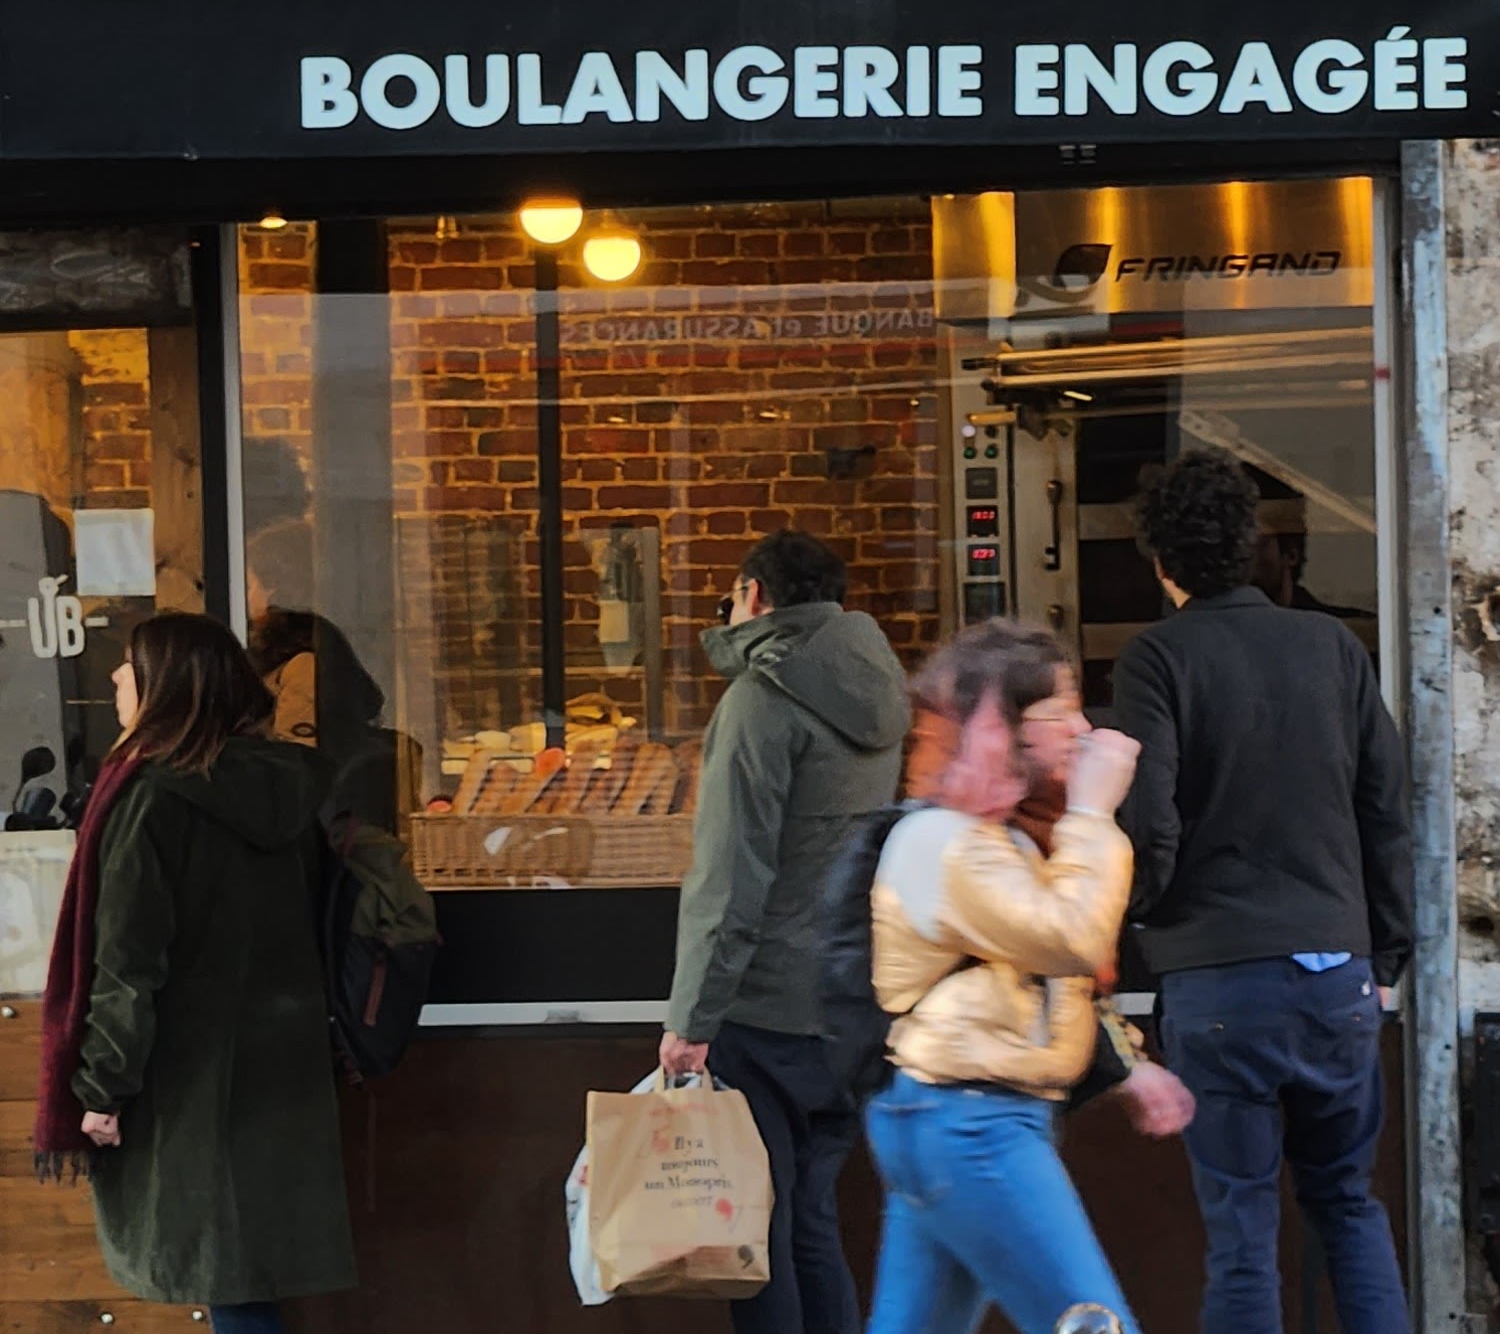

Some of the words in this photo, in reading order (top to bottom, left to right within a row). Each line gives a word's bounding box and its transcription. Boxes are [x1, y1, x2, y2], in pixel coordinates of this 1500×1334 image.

[300, 44, 983, 130] BOULANGERIE
[1014, 25, 1470, 118] ENGAGÉE
[1115, 251, 1342, 283] FRINGAND
